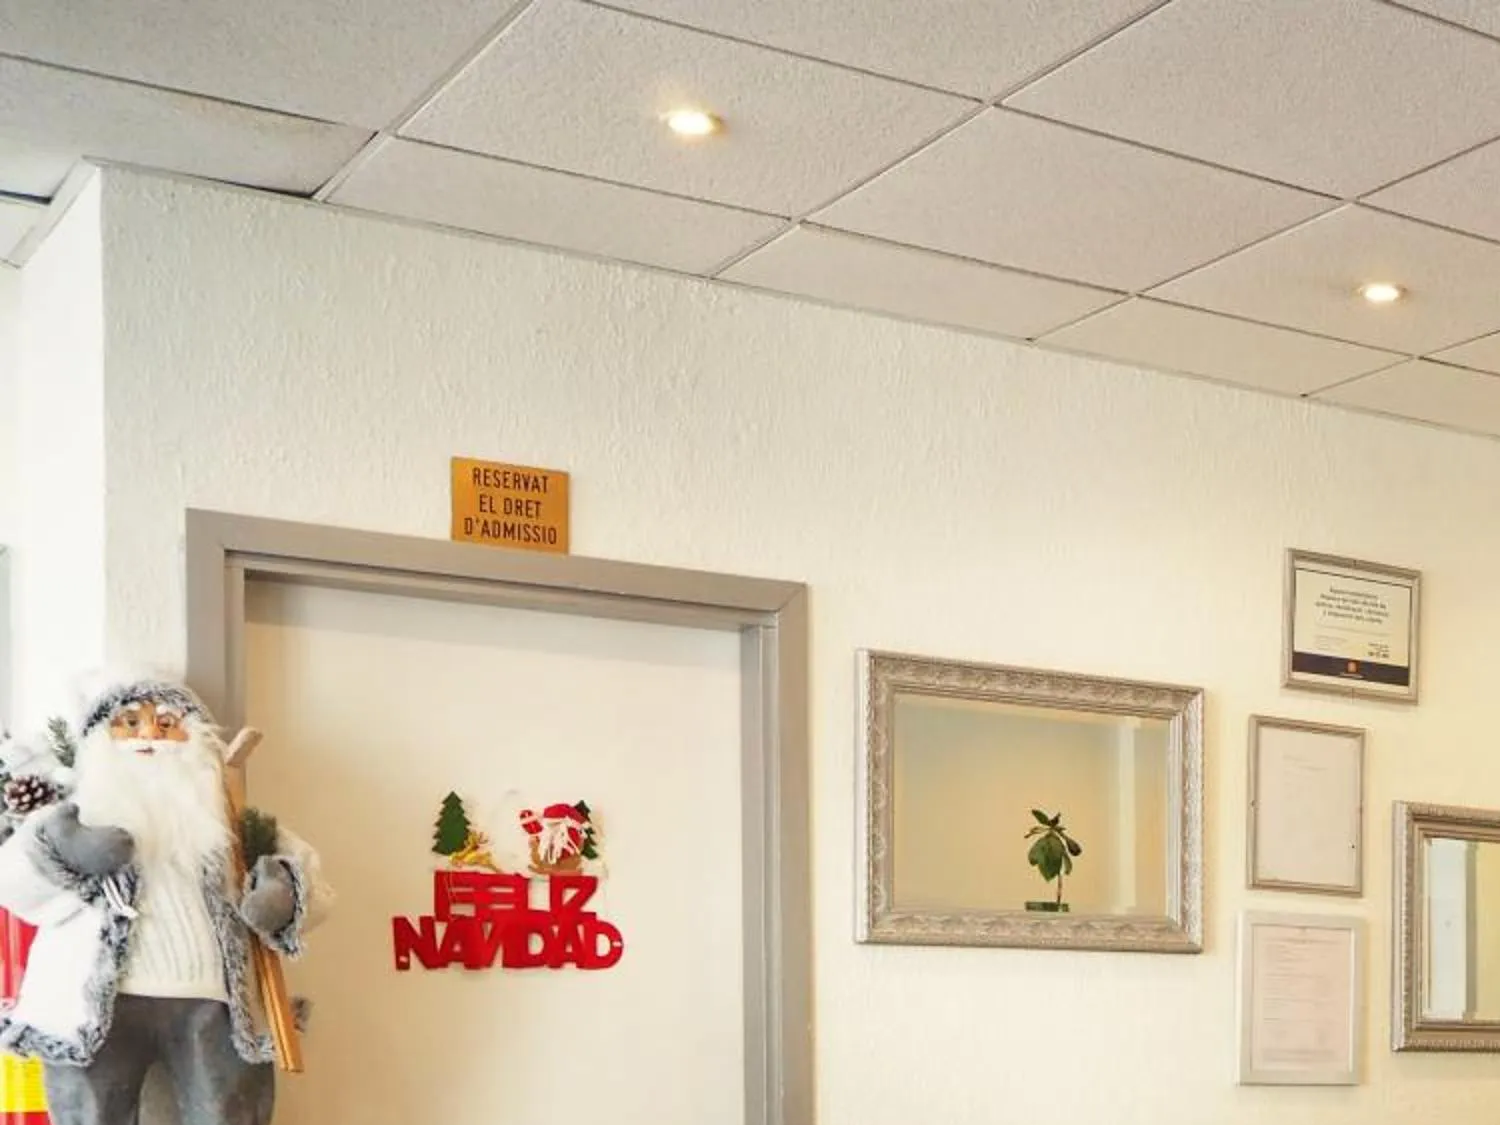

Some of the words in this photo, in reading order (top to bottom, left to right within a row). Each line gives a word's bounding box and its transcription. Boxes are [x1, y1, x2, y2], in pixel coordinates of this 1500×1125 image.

[472, 467, 549, 494] RESERVAT
[479, 494, 497, 514] EL
[503, 497, 541, 520] DRET
[464, 517, 557, 545] D'ADMISSIO
[434, 870, 599, 922] FELIZ
[392, 914, 624, 971] NAVIDAD
